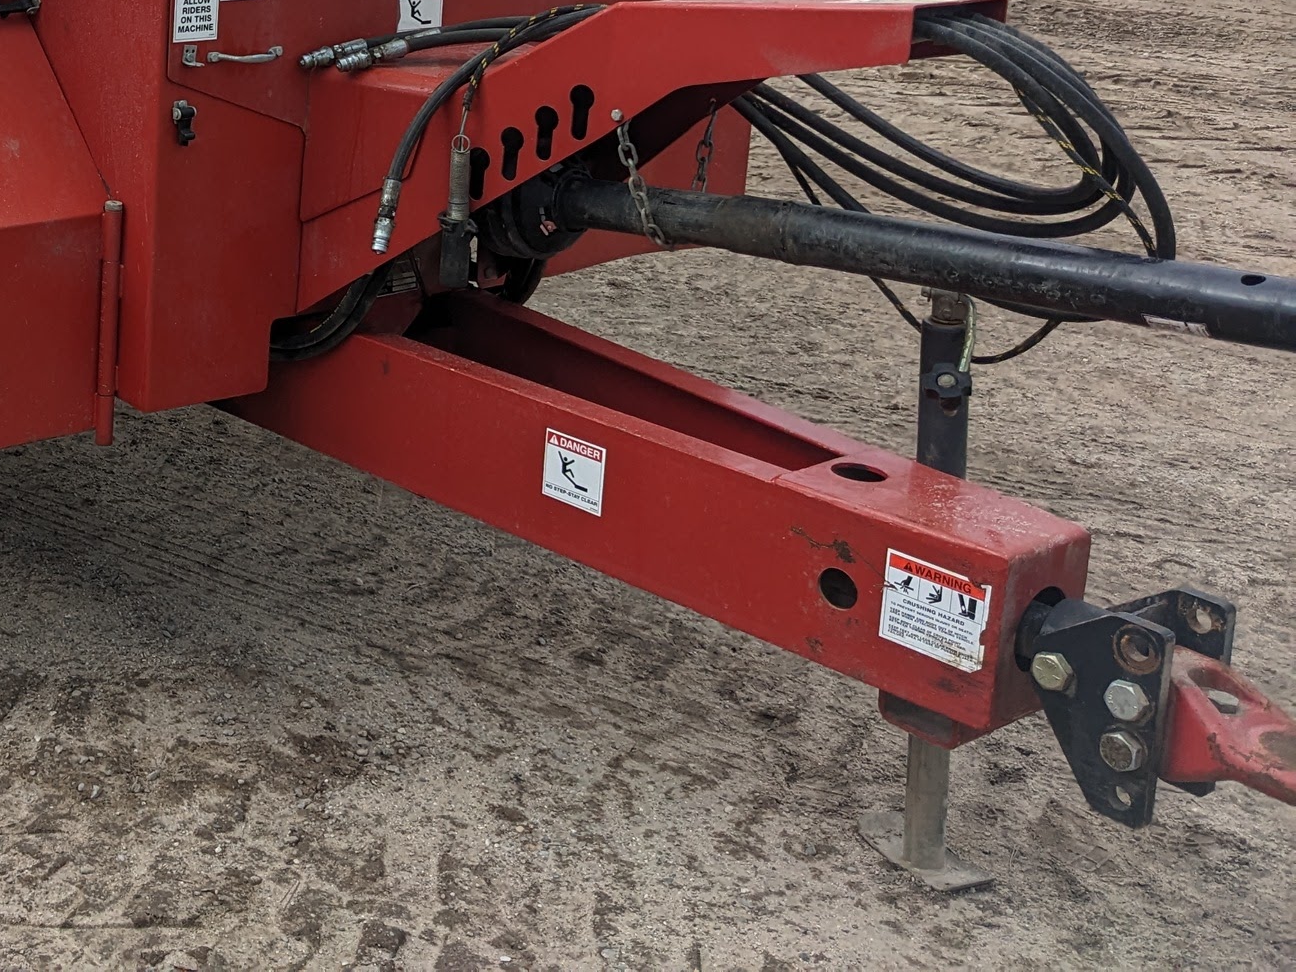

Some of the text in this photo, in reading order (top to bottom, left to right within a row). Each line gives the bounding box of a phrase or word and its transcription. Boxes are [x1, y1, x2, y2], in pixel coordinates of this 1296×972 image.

[182, 6, 211, 15] RIDERS
[180, 14, 212, 24] ON THIS
[178, 24, 214, 33] MACHINE
[560, 438, 601, 460] DANGER
[580, 496, 598, 507] CLEAR
[914, 563, 972, 594] WARNING
[902, 599, 965, 626] CRUSHING HAZARD
